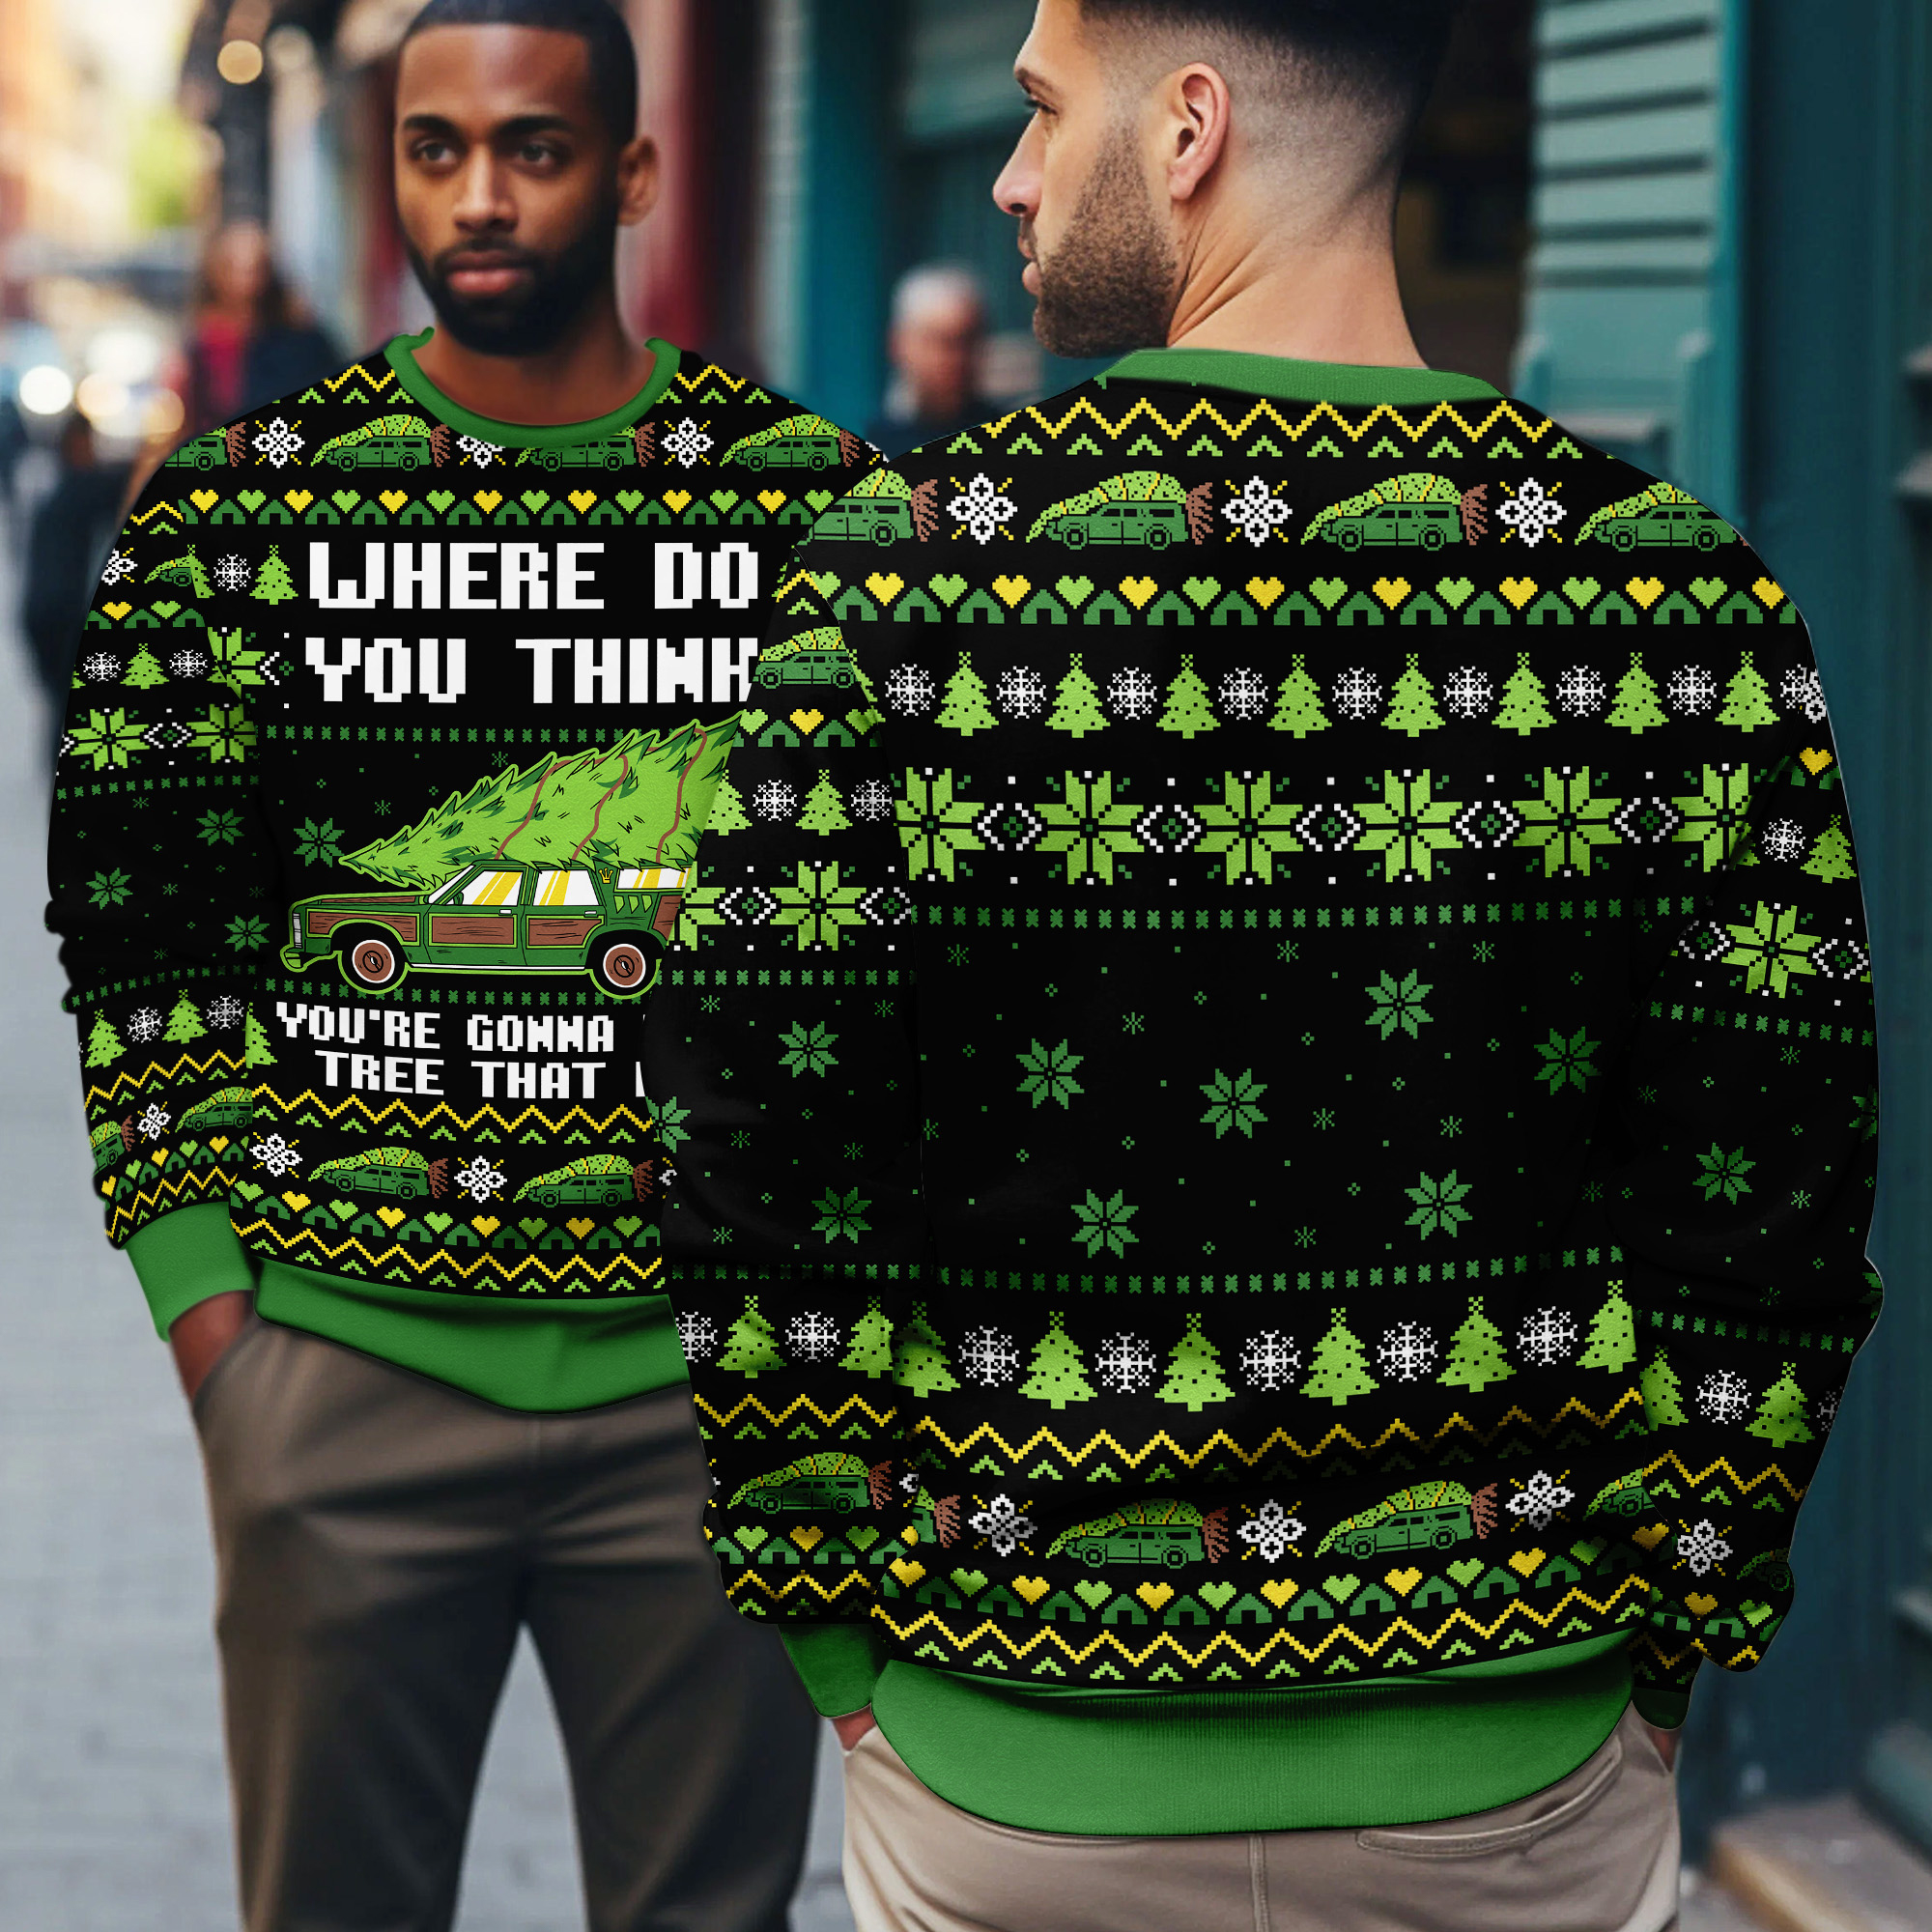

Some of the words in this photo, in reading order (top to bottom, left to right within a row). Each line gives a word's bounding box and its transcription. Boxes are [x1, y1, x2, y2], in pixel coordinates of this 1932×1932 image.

[310, 542, 604, 609] WHERE
[655, 542, 758, 609] DO
[305, 638, 466, 703] YOU
[516, 638, 758, 703] THINK
[276, 1002, 440, 1049] YOU'RE
[468, 1014, 614, 1052] GONNA
[315, 1050, 444, 1095] TREE
[471, 1061, 606, 1098] THAT
